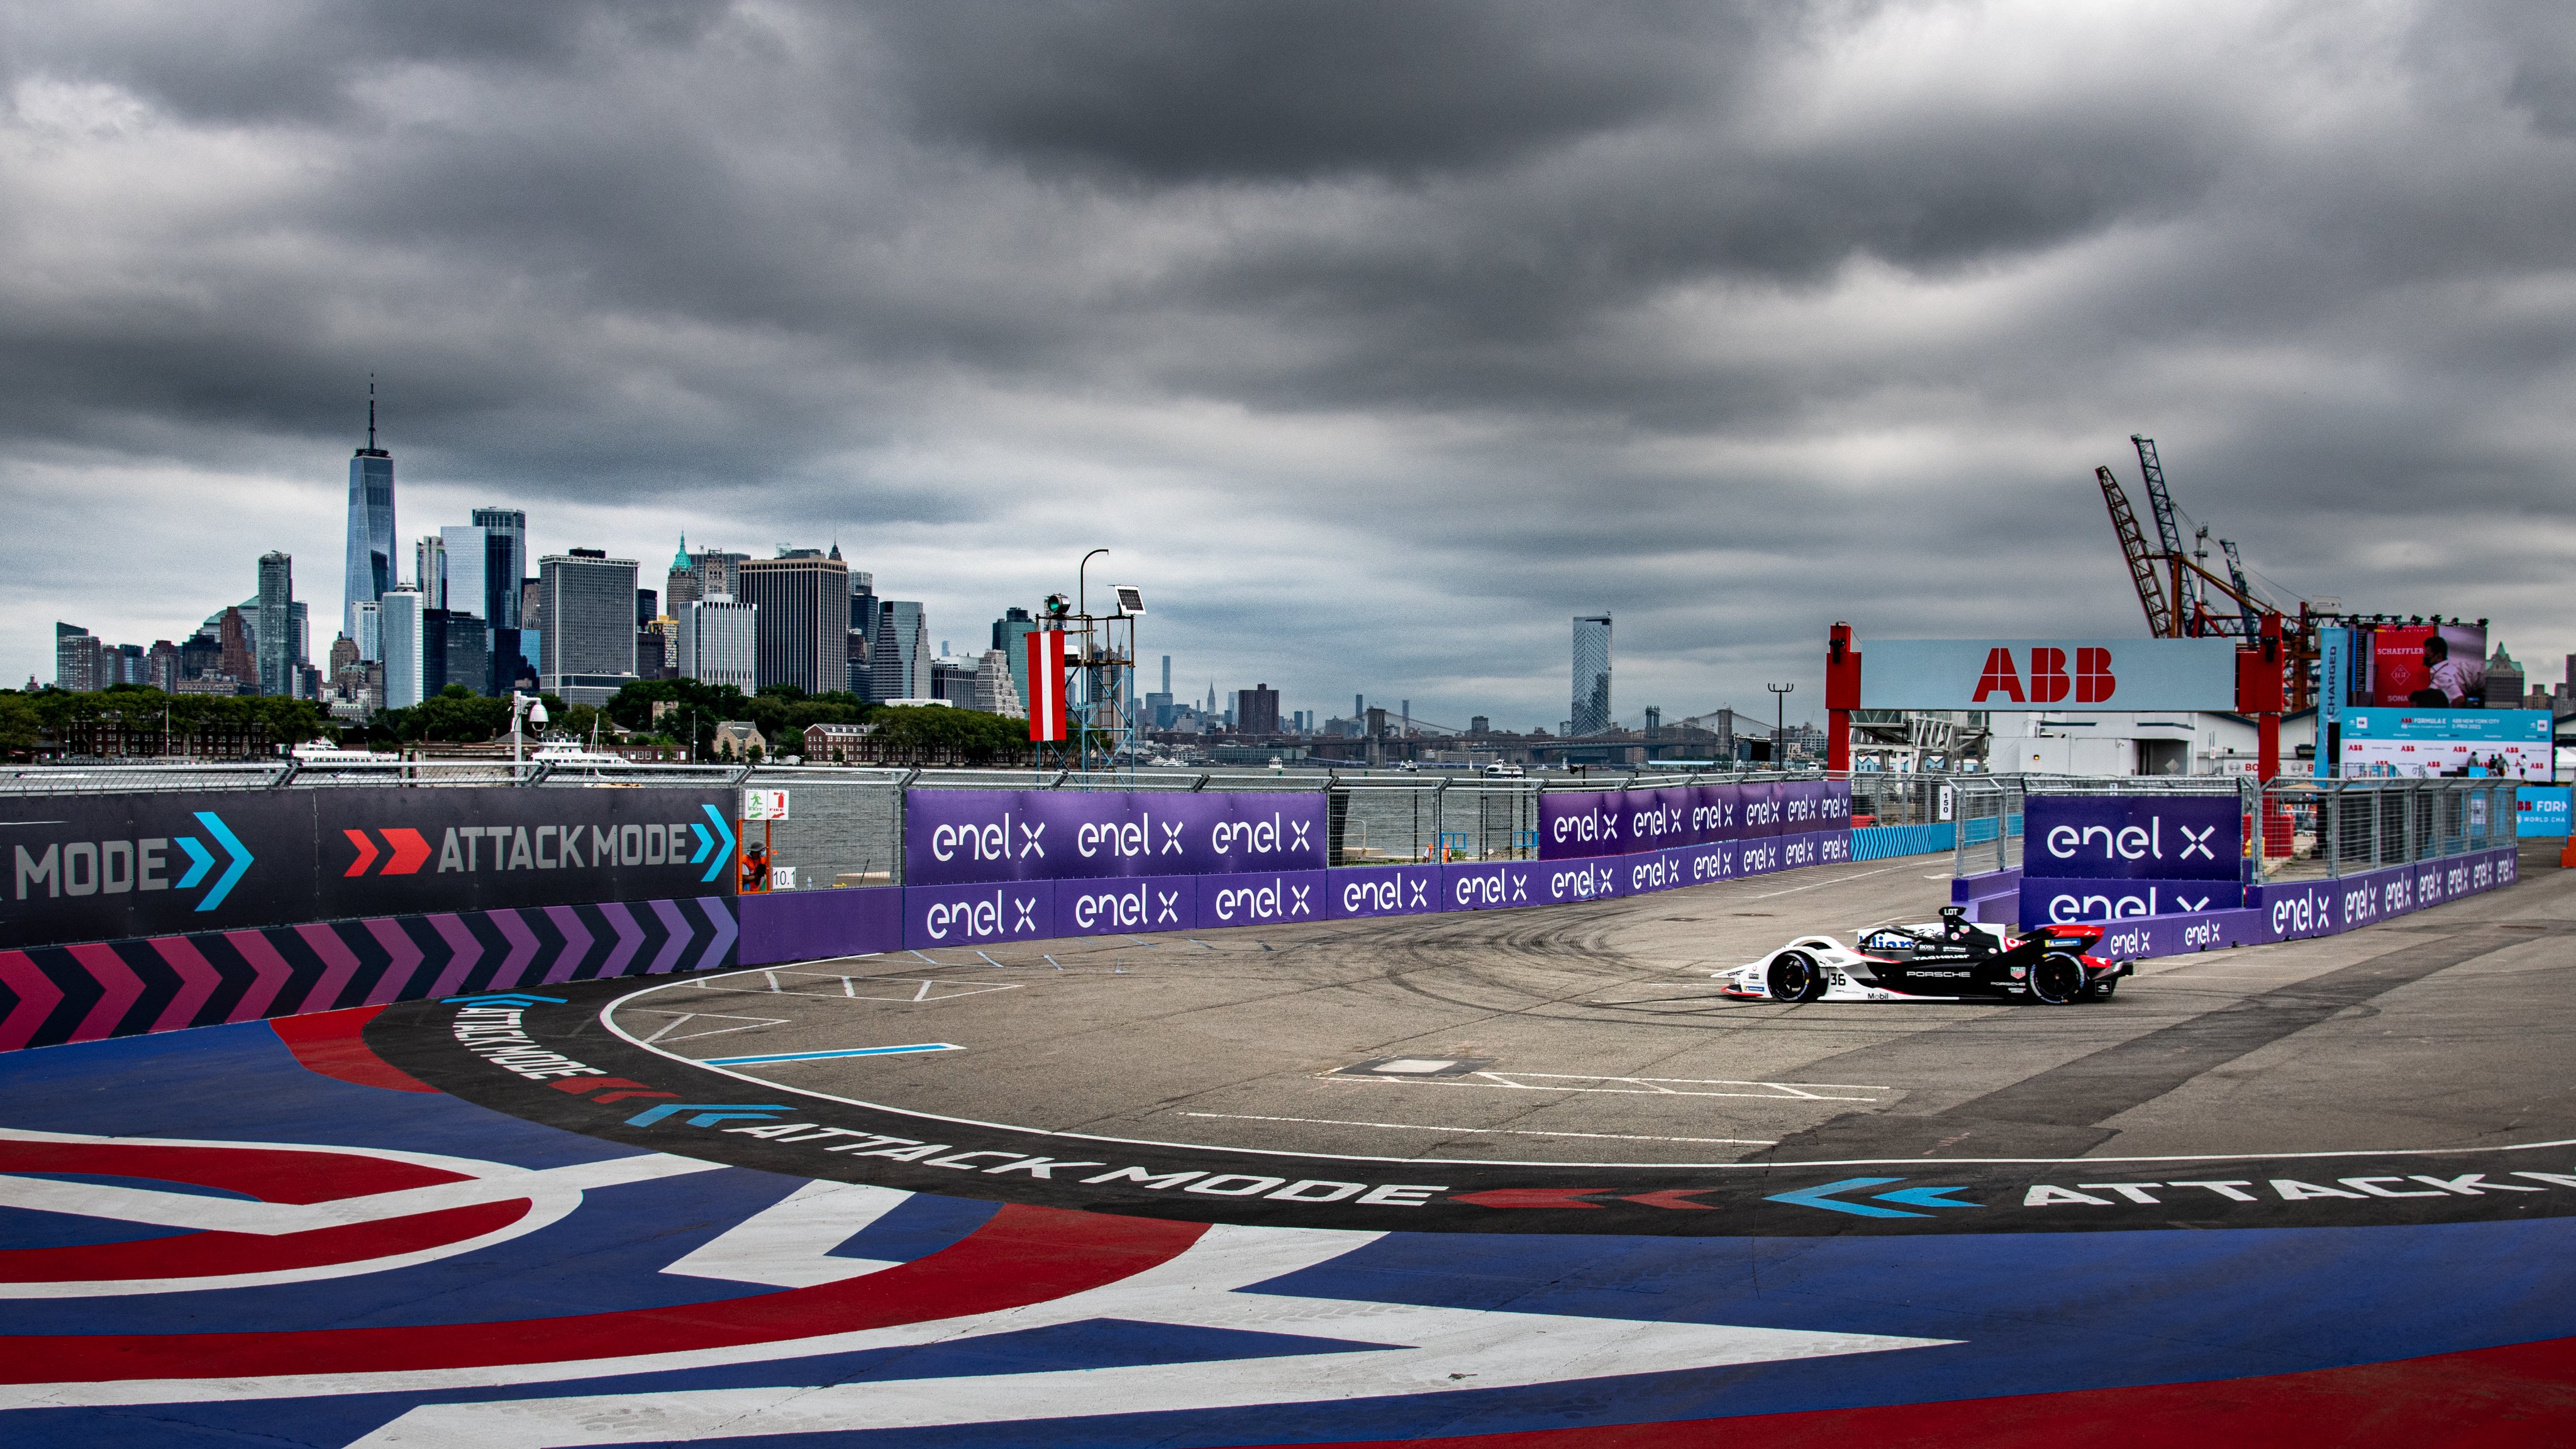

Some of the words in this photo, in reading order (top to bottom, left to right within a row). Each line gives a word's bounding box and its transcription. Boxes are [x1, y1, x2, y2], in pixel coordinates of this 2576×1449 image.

[1973, 648, 2116, 702] ABB
[2328, 646, 2336, 716] CHARGED
[1634, 803, 1667, 838] enel
[1671, 809, 1682, 833] x
[1693, 799, 1721, 831] enel
[1724, 804, 1733, 827] x
[1747, 796, 1770, 826] enel
[1771, 802, 1780, 823] x
[1789, 794, 1808, 822] enel
[1809, 799, 1816, 819] x
[1822, 792, 1840, 819] enel
[1841, 797, 1848, 817] x
[933, 813, 1011, 862] enel
[1021, 822, 1045, 858] x
[1079, 813, 1150, 857] enel
[1162, 821, 1183, 855] x
[1213, 812, 1281, 853] enel
[1291, 820, 1310, 852] x
[1554, 808, 1598, 843] enel
[1604, 814, 1618, 840] x
[2048, 816, 2162, 859] enel
[2180, 826, 2214, 860] x
[438, 826, 585, 873] ATTACK
[593, 824, 687, 867] MODE
[1694, 849, 1720, 880] enel
[1723, 853, 1731, 875] x
[1743, 842, 1767, 872] enel
[1768, 847, 1776, 868] x
[1786, 837, 1806, 865] enel
[1807, 842, 1814, 862] x
[1823, 835, 1840, 860] enel
[1841, 840, 1848, 858] x
[16, 838, 169, 900] MODE
[774, 871, 795, 886] 10.1
[1552, 863, 1596, 897] enel
[1601, 868, 1613, 893] x
[1633, 855, 1666, 890] enel
[1670, 860, 1679, 884] x
[2419, 866, 2435, 903] enel
[2448, 861, 2463, 896] enel
[2473, 857, 2487, 889] enel
[2497, 854, 2509, 883] enel
[1216, 879, 1282, 919] enel
[1292, 885, 1310, 915] x
[1344, 873, 1402, 912] enel
[1411, 879, 1427, 908] x
[1457, 869, 1506, 905] enel
[1513, 875, 1526, 901] x
[2345, 880, 2367, 924] enel
[2385, 873, 2404, 912] enel
[928, 890, 1004, 939] enel
[1015, 897, 1036, 933] x
[1076, 884, 1148, 928] enel
[1158, 891, 1178, 923] x
[2049, 887, 2156, 924] enel
[2273, 888, 2313, 934] enel
[2111, 928, 2138, 955] enel
[2141, 932, 2150, 952] x
[2185, 920, 2210, 946] enel
[2212, 924, 2220, 941] x
[1830, 973, 1846, 986] 36
[453, 1008, 536, 1046] ATTACK
[470, 1045, 609, 1080] MODE
[720, 1123, 1108, 1179] ATTACK
[1079, 1166, 1450, 1206] MODE
[2023, 1174, 2550, 1206] ATTACK
